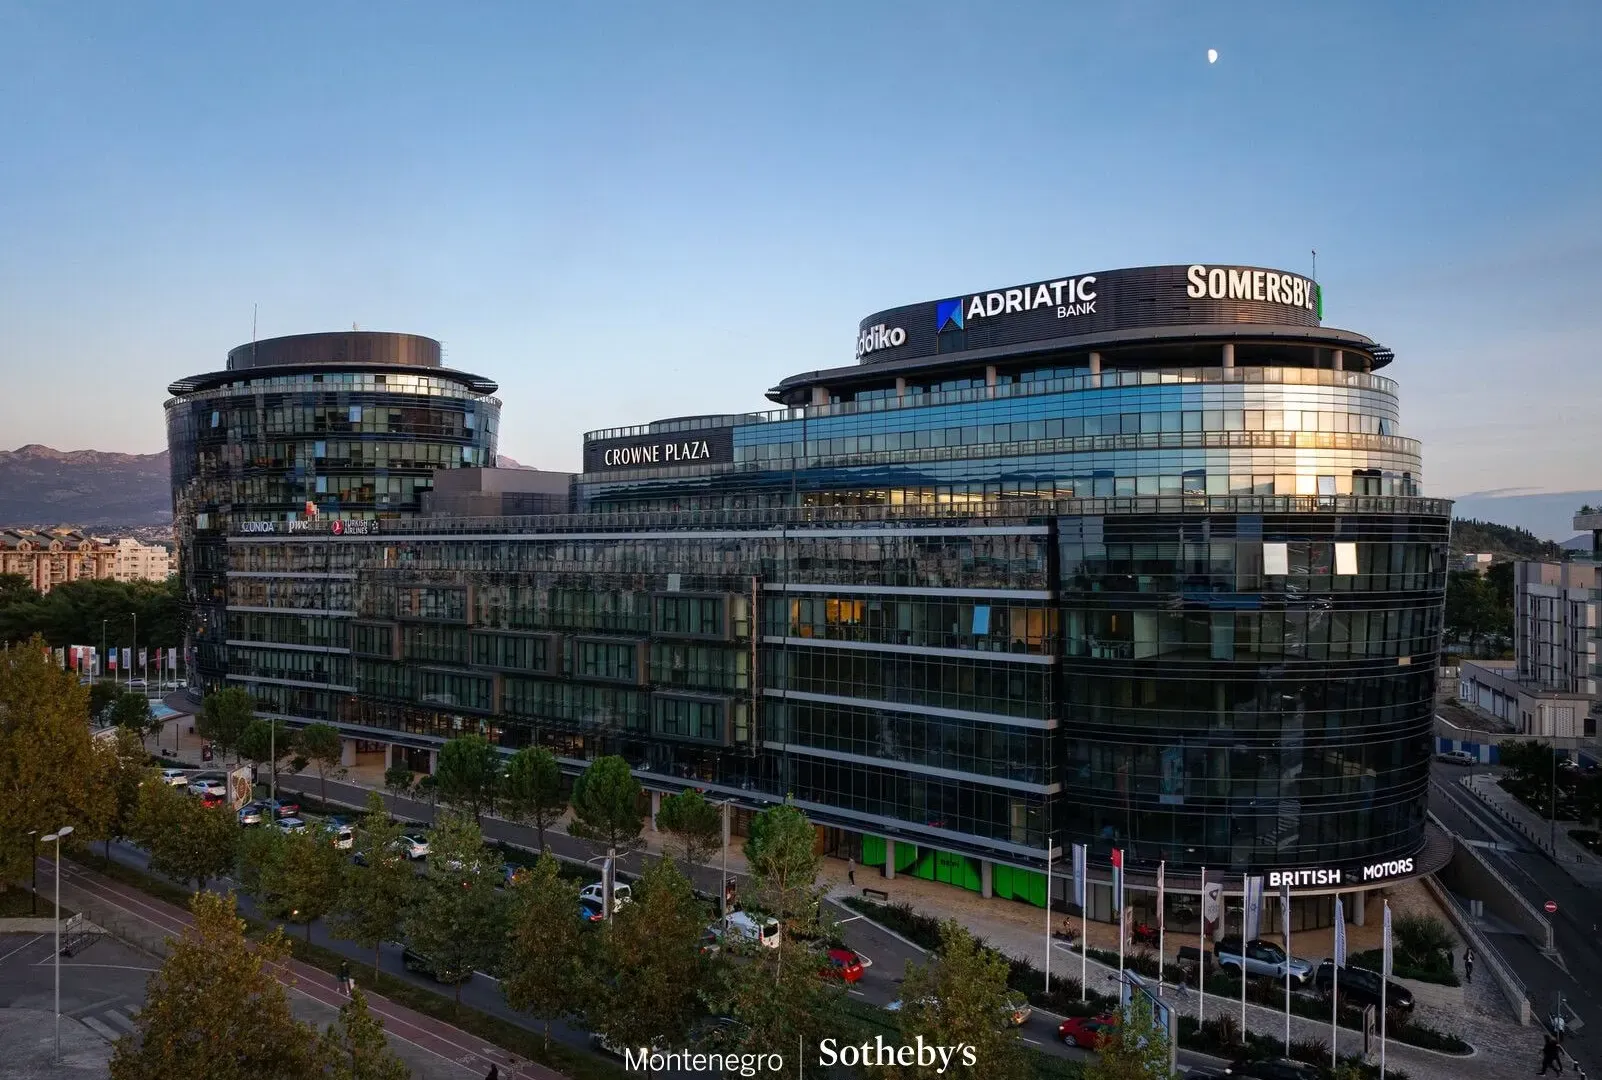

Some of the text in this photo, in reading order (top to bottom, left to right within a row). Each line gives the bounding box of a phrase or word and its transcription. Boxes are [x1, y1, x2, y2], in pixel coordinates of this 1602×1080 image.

[967, 276, 1097, 320] ADRIATIC
[1057, 301, 1097, 319] BANK
[857, 323, 906, 358] ddiko
[605, 440, 710, 466] CROWNE PLAZA
[288, 520, 308, 534] pwc
[344, 519, 368, 527] TURKISH
[344, 526, 368, 535] AIRLINES
[1269, 858, 1413, 887] BRITISH MOTORS
